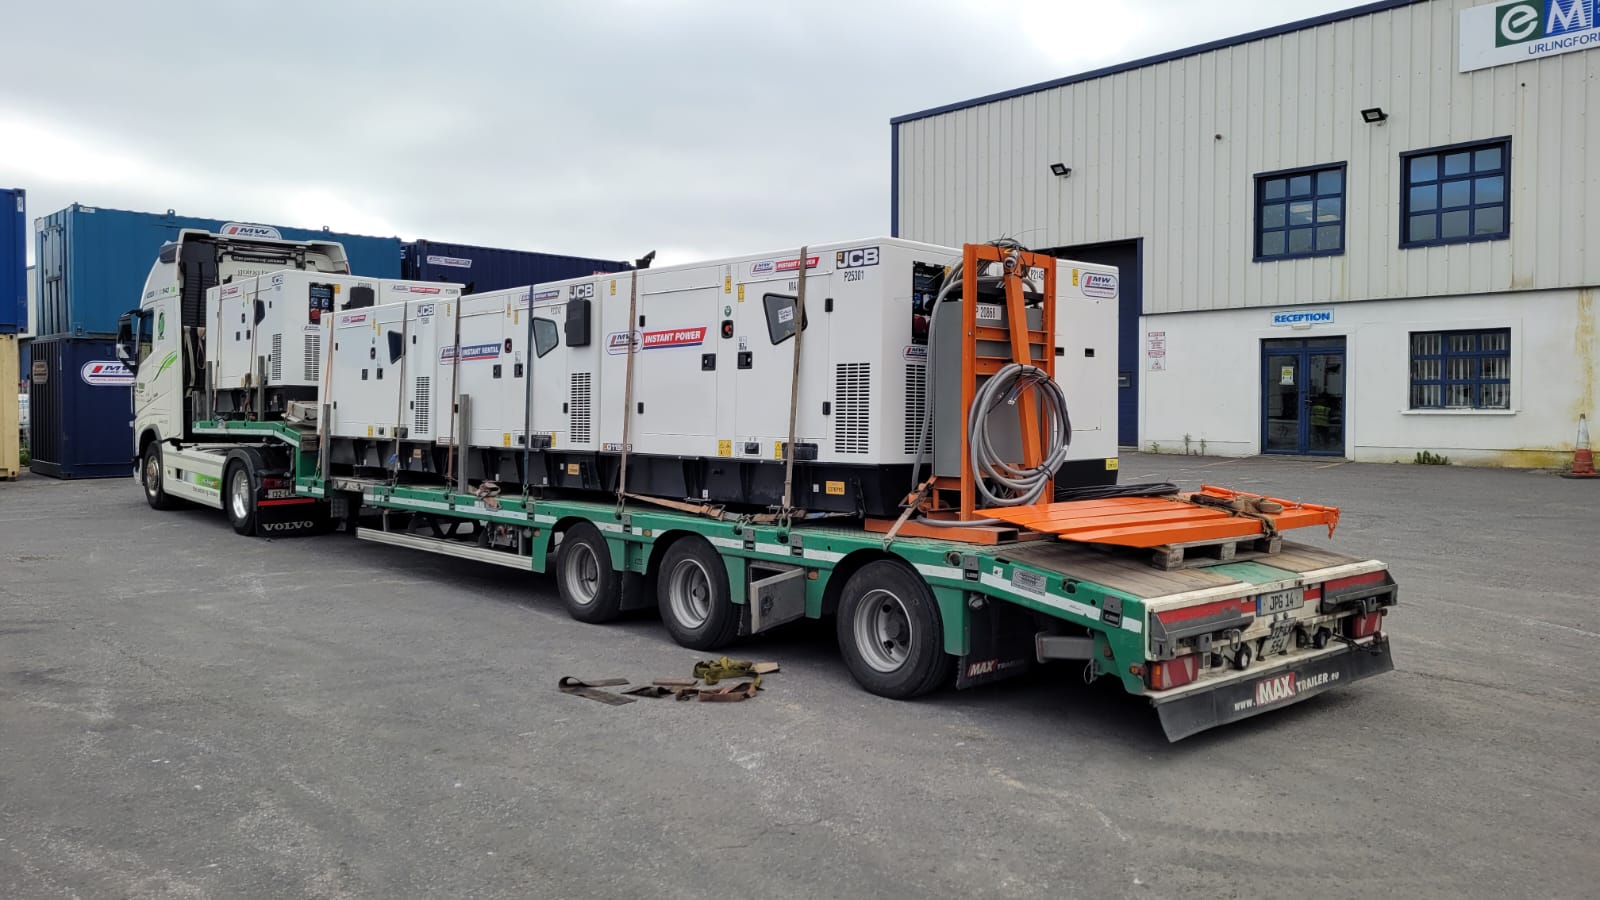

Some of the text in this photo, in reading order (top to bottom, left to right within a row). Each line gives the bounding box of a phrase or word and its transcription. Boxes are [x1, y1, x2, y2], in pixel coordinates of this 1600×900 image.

[1528, 31, 1600, 55] URLINGFOR
[240, 227, 269, 235] MW
[838, 247, 879, 269] JCB
[844, 270, 865, 282] P25301
[569, 283, 593, 299] JCB
[1274, 312, 1331, 323] RECEPTION
[645, 330, 701, 343] INSTANT POWER
[262, 520, 314, 531] VOLVO
[1269, 592, 1294, 611] JPG 14
[969, 660, 995, 677] MAX
[1234, 698, 1256, 711] www.
[1259, 675, 1294, 705] MAX
